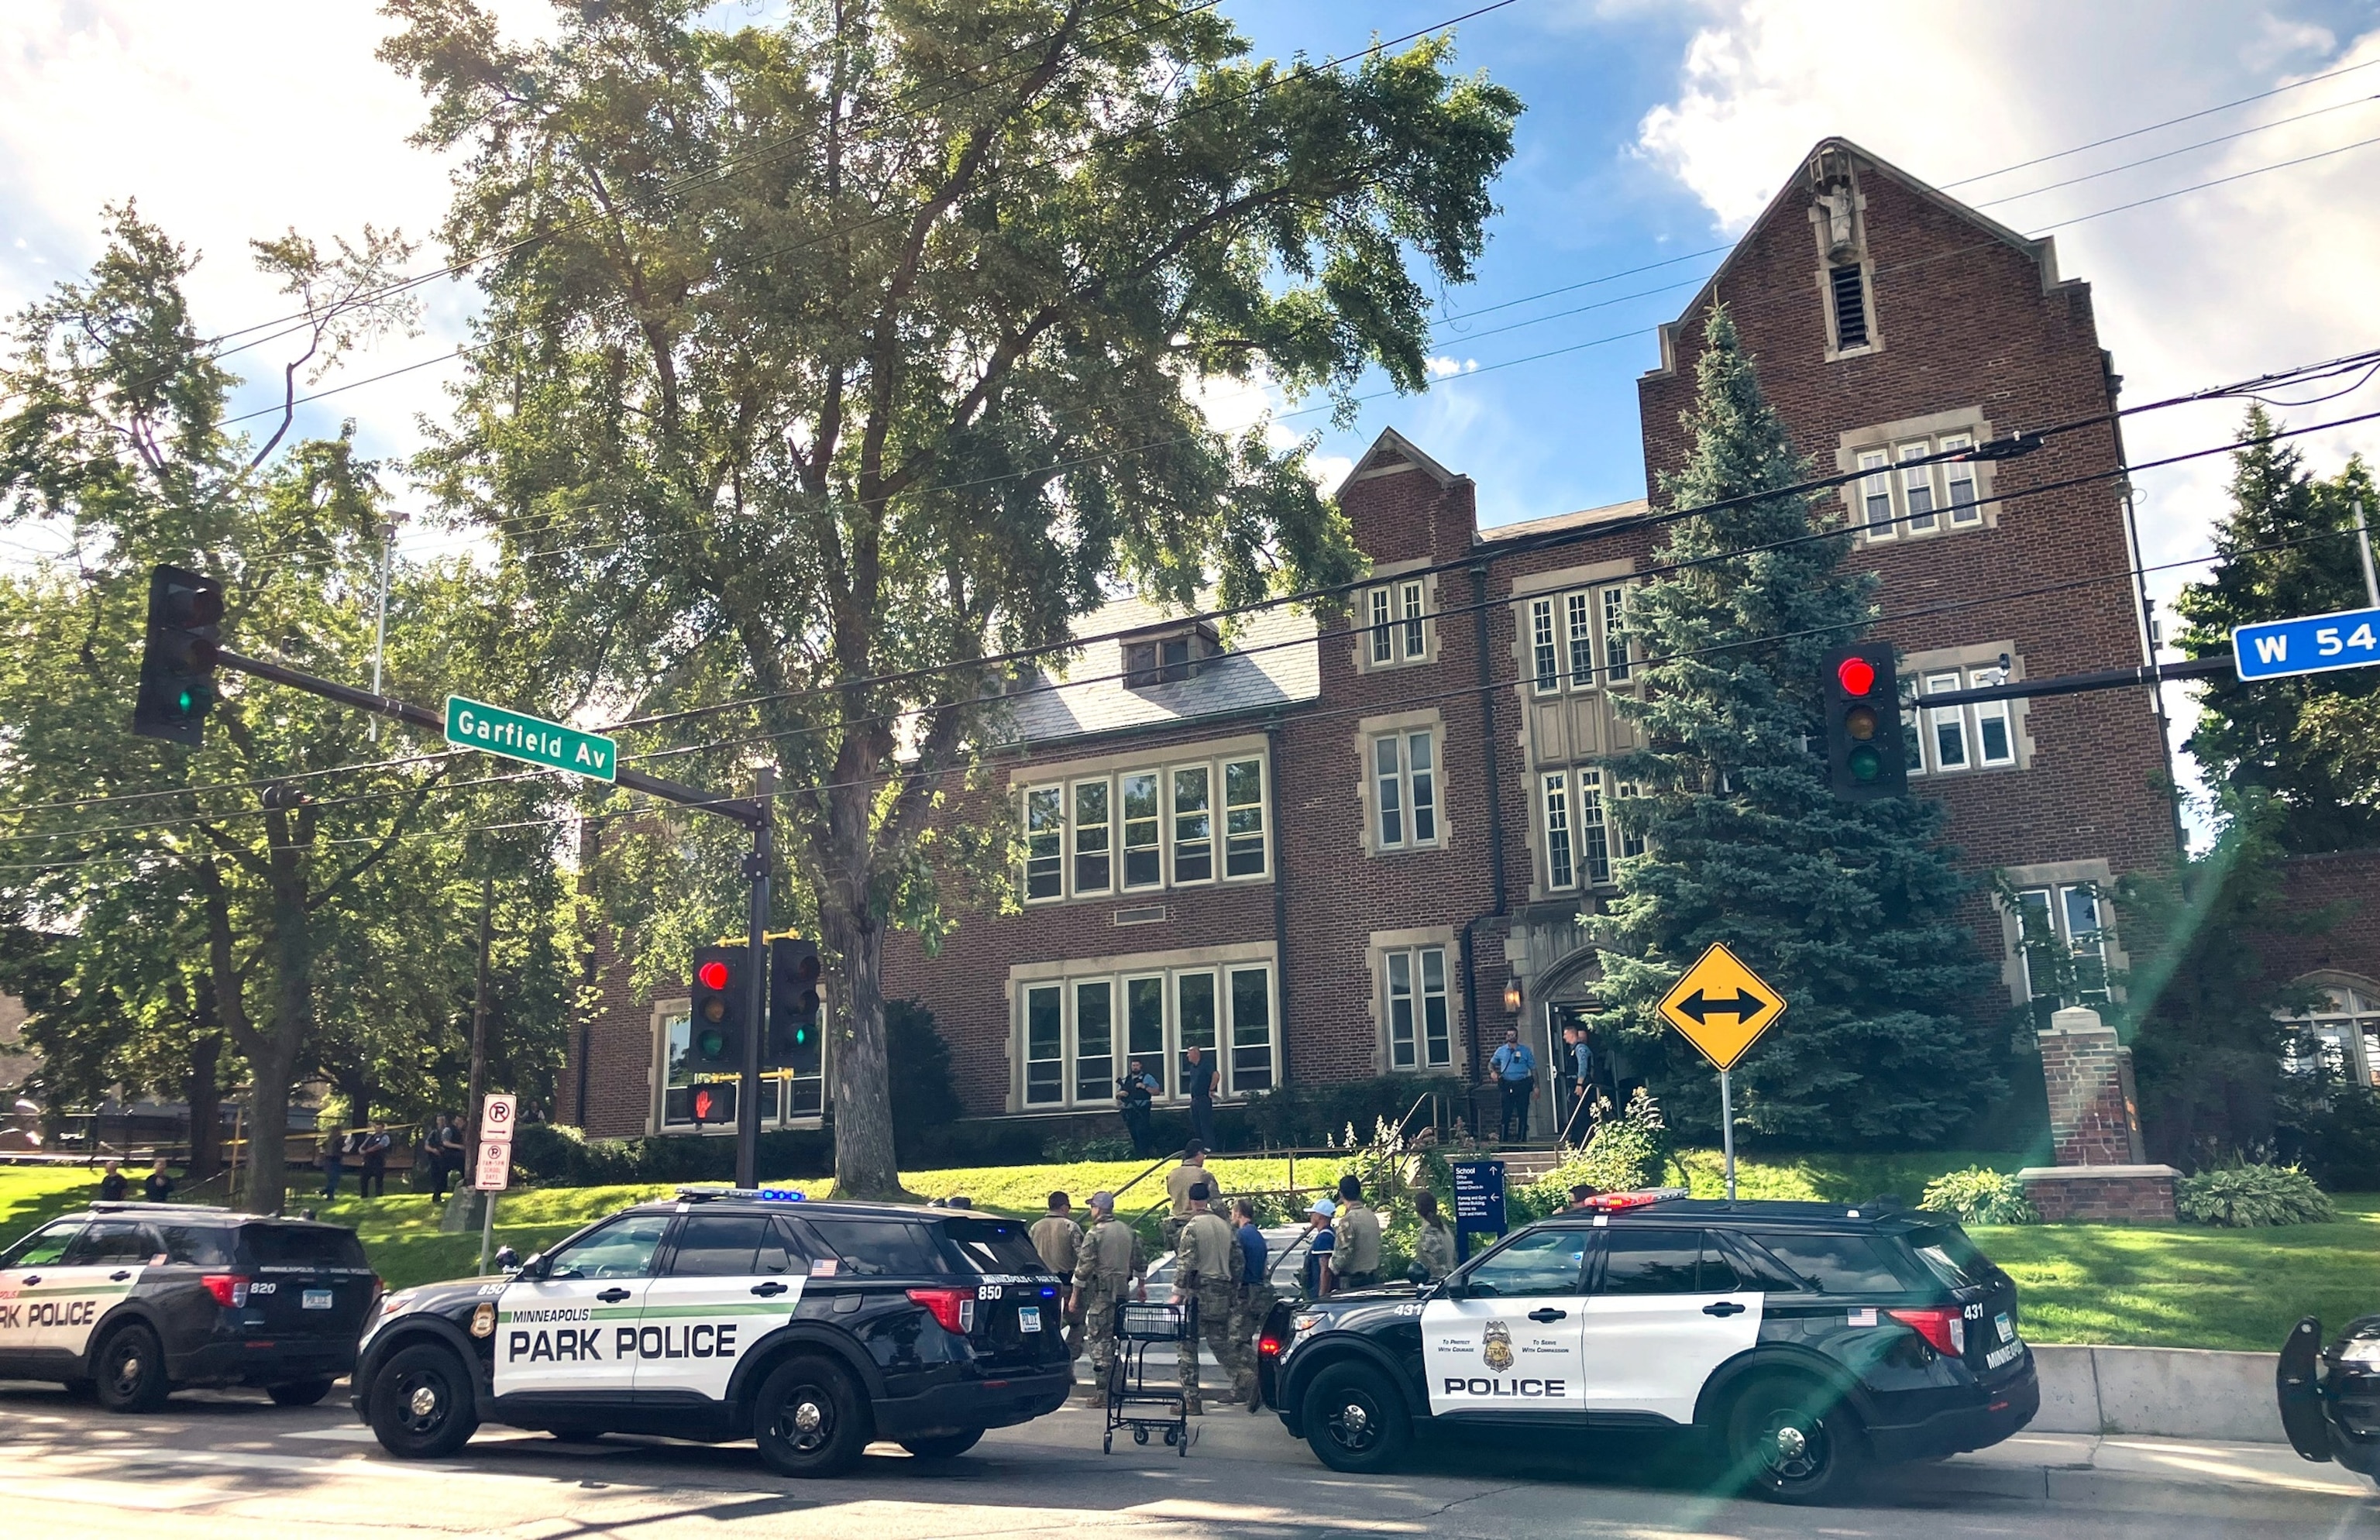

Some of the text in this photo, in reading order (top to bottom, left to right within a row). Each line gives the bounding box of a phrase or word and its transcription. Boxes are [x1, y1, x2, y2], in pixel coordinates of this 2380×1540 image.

[2254, 623, 2378, 664] W 54
[458, 710, 606, 769] Garfield Av
[249, 1283, 277, 1294] 820
[476, 1284, 507, 1296] 850
[978, 1285, 1003, 1301] 850
[27, 1301, 97, 1327] POLICE
[512, 1308, 590, 1324] MINNEAPOLIS
[1394, 1303, 1422, 1316] 431
[1964, 1302, 1983, 1321] 431
[508, 1323, 738, 1363] PARK POLICE
[1444, 1377, 1566, 1397] POLICE
